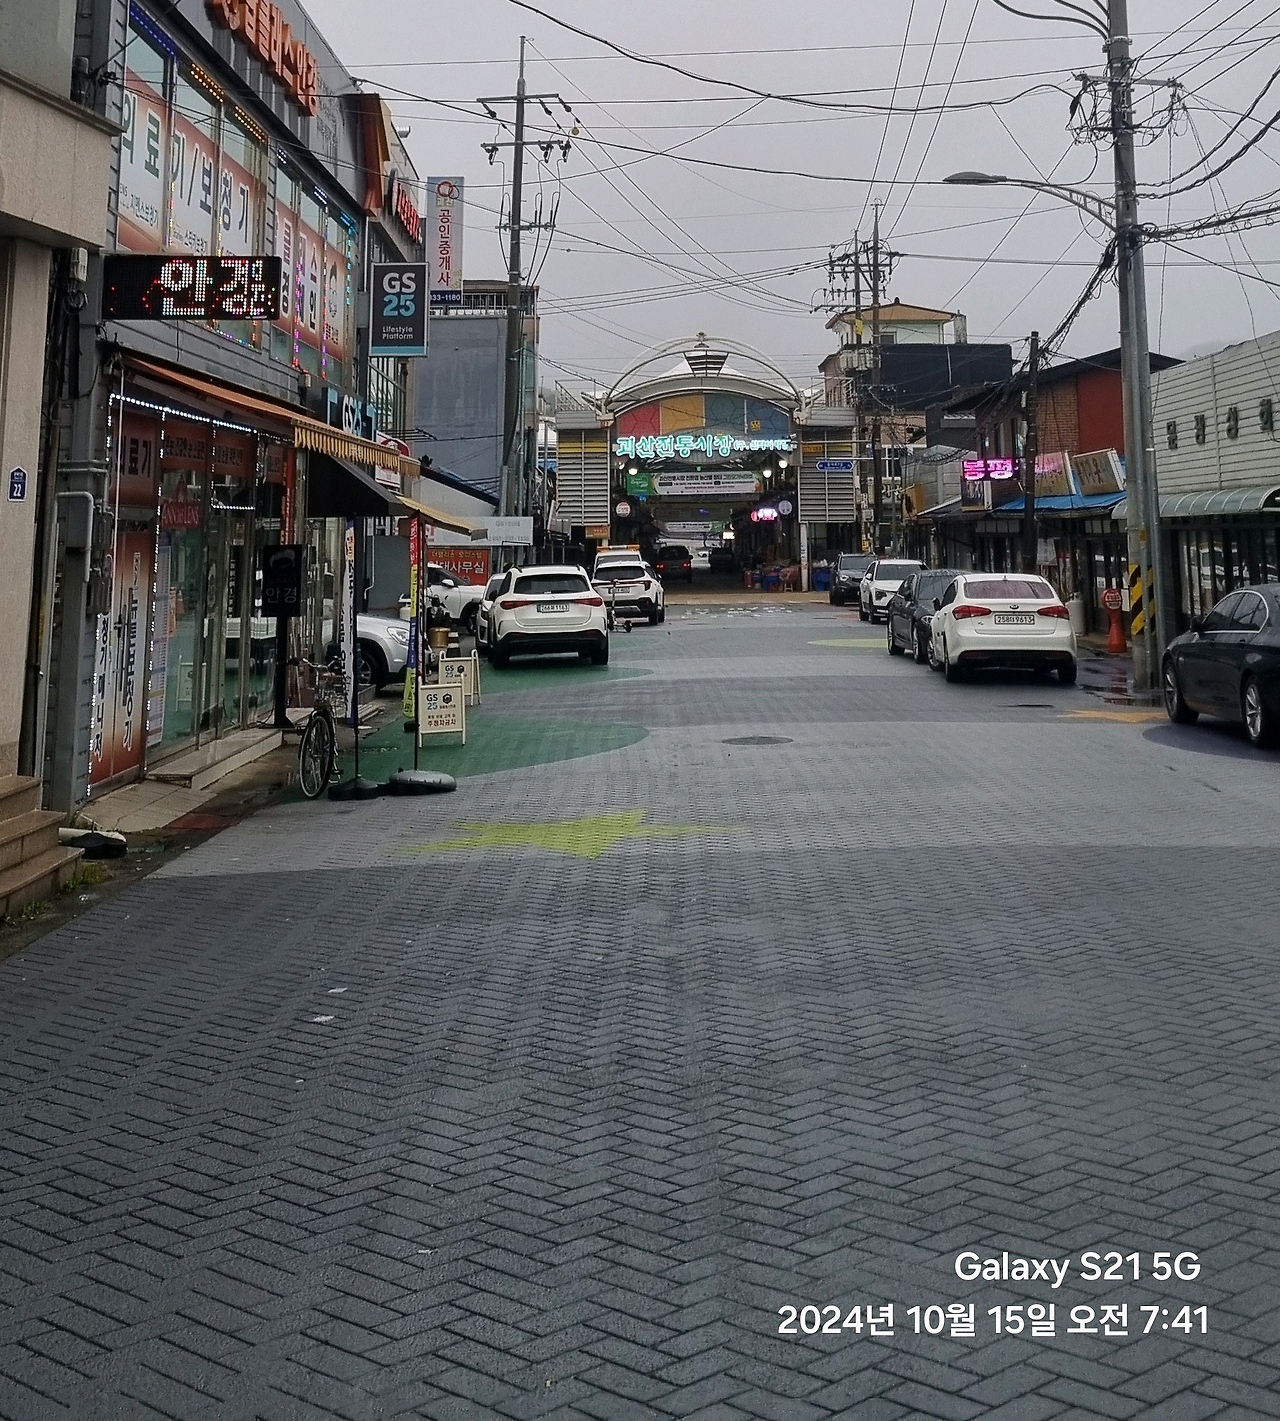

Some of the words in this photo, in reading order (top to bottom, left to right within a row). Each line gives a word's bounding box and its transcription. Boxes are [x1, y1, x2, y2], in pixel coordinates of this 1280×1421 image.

[438, 209, 452, 287] 공인중개사
[382, 272, 417, 294] GS
[382, 294, 416, 317] 25
[382, 326, 413, 334] Lifestyle
[615, 434, 733, 459] 괴산전통시장
[13, 483, 22, 497] 22
[430, 561, 485, 575] 대사무실
[265, 586, 298, 604] 안경
[445, 664, 455, 672] GS
[426, 693, 438, 702] GS
[427, 701, 438, 710] 25
